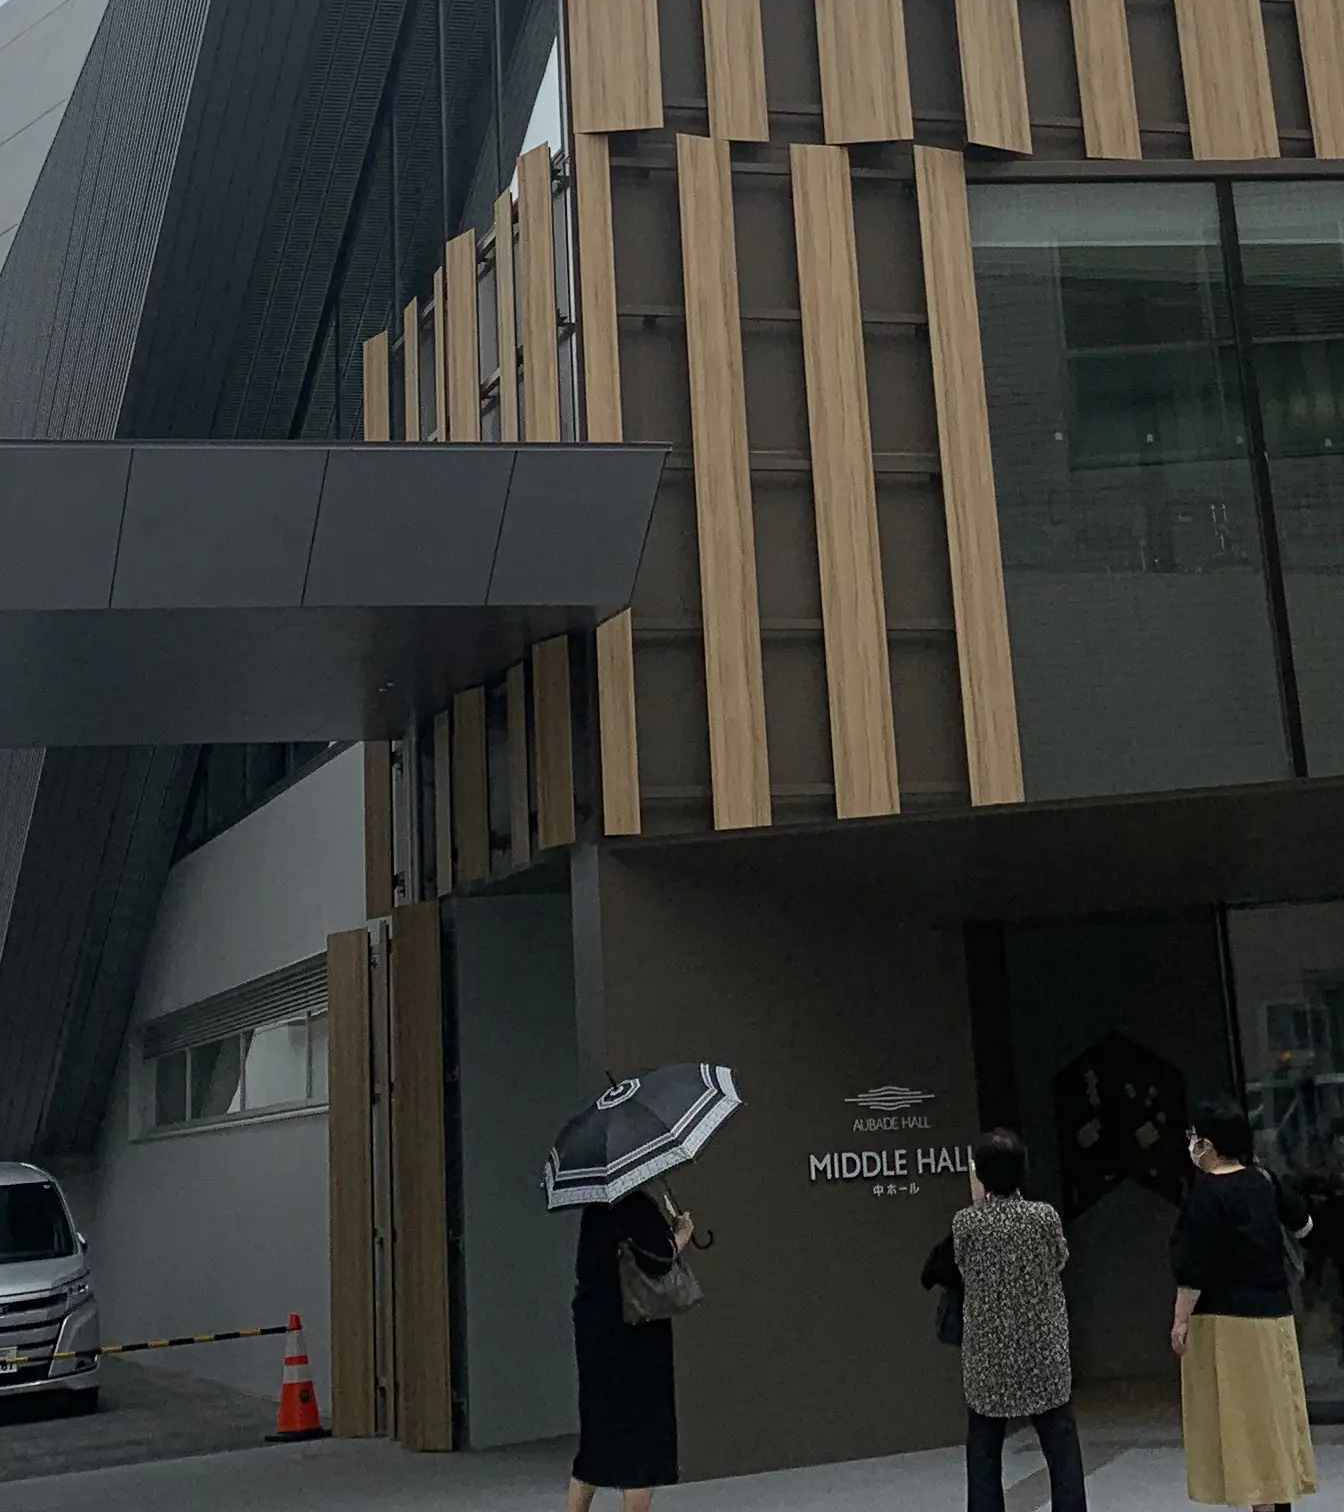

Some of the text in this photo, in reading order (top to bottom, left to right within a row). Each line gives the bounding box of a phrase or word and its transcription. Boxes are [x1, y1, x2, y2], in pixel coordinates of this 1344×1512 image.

[853, 1115, 931, 1132] AUBADE HALL
[809, 1149, 908, 1181] MIDDLE
[872, 1181, 920, 1197] 中ホール
